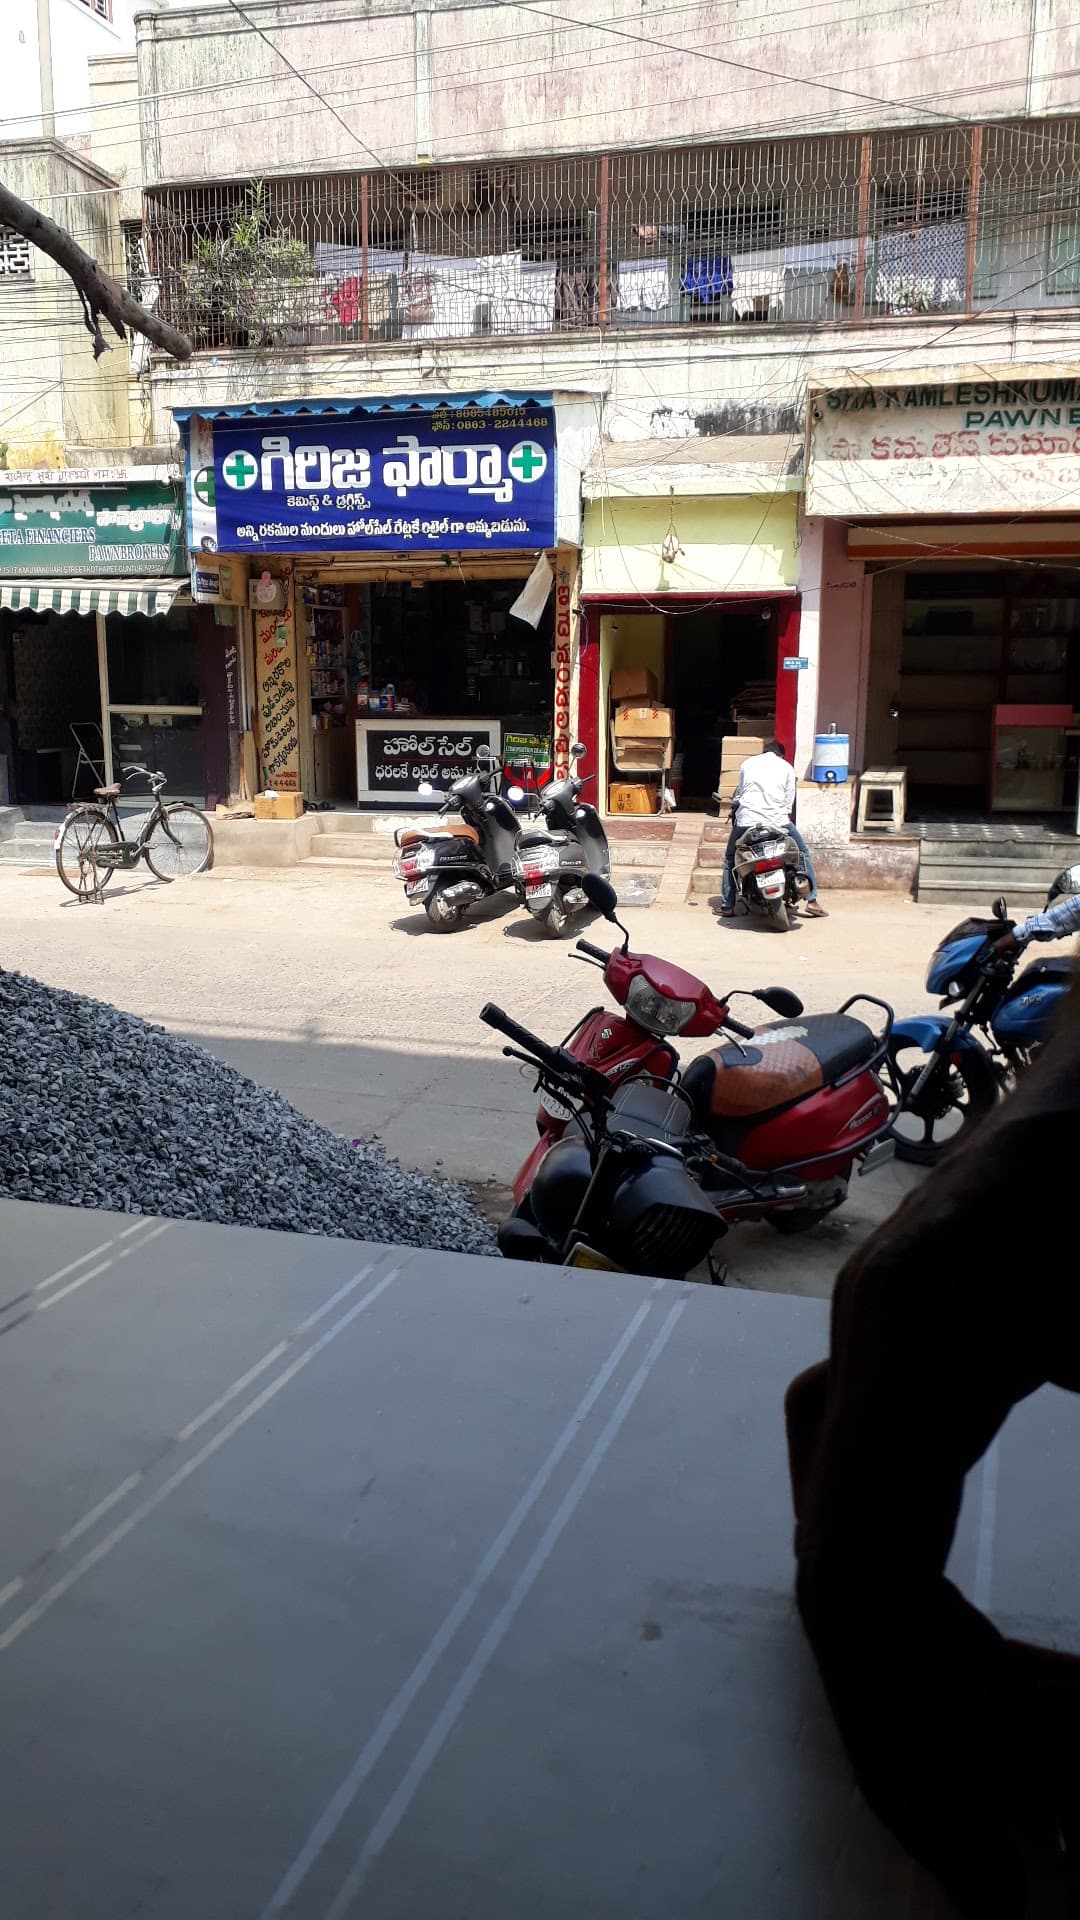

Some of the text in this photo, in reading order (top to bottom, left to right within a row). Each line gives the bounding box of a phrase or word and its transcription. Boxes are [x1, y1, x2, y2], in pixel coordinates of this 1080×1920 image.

[494, 418, 548, 429] 2244468
[965, 409, 1061, 428] PAWN
[260, 436, 513, 503] గిరిజ ఫార్మా
[322, 494, 333, 506] &
[26, 527, 96, 545] FINANCIERS
[236, 524, 259, 541] అన్ని
[259, 522, 298, 537] రకముల
[300, 521, 345, 537] మందులు
[88, 545, 171, 562] PAWNBROKERS
[375, 762, 409, 780] ధరలకే
